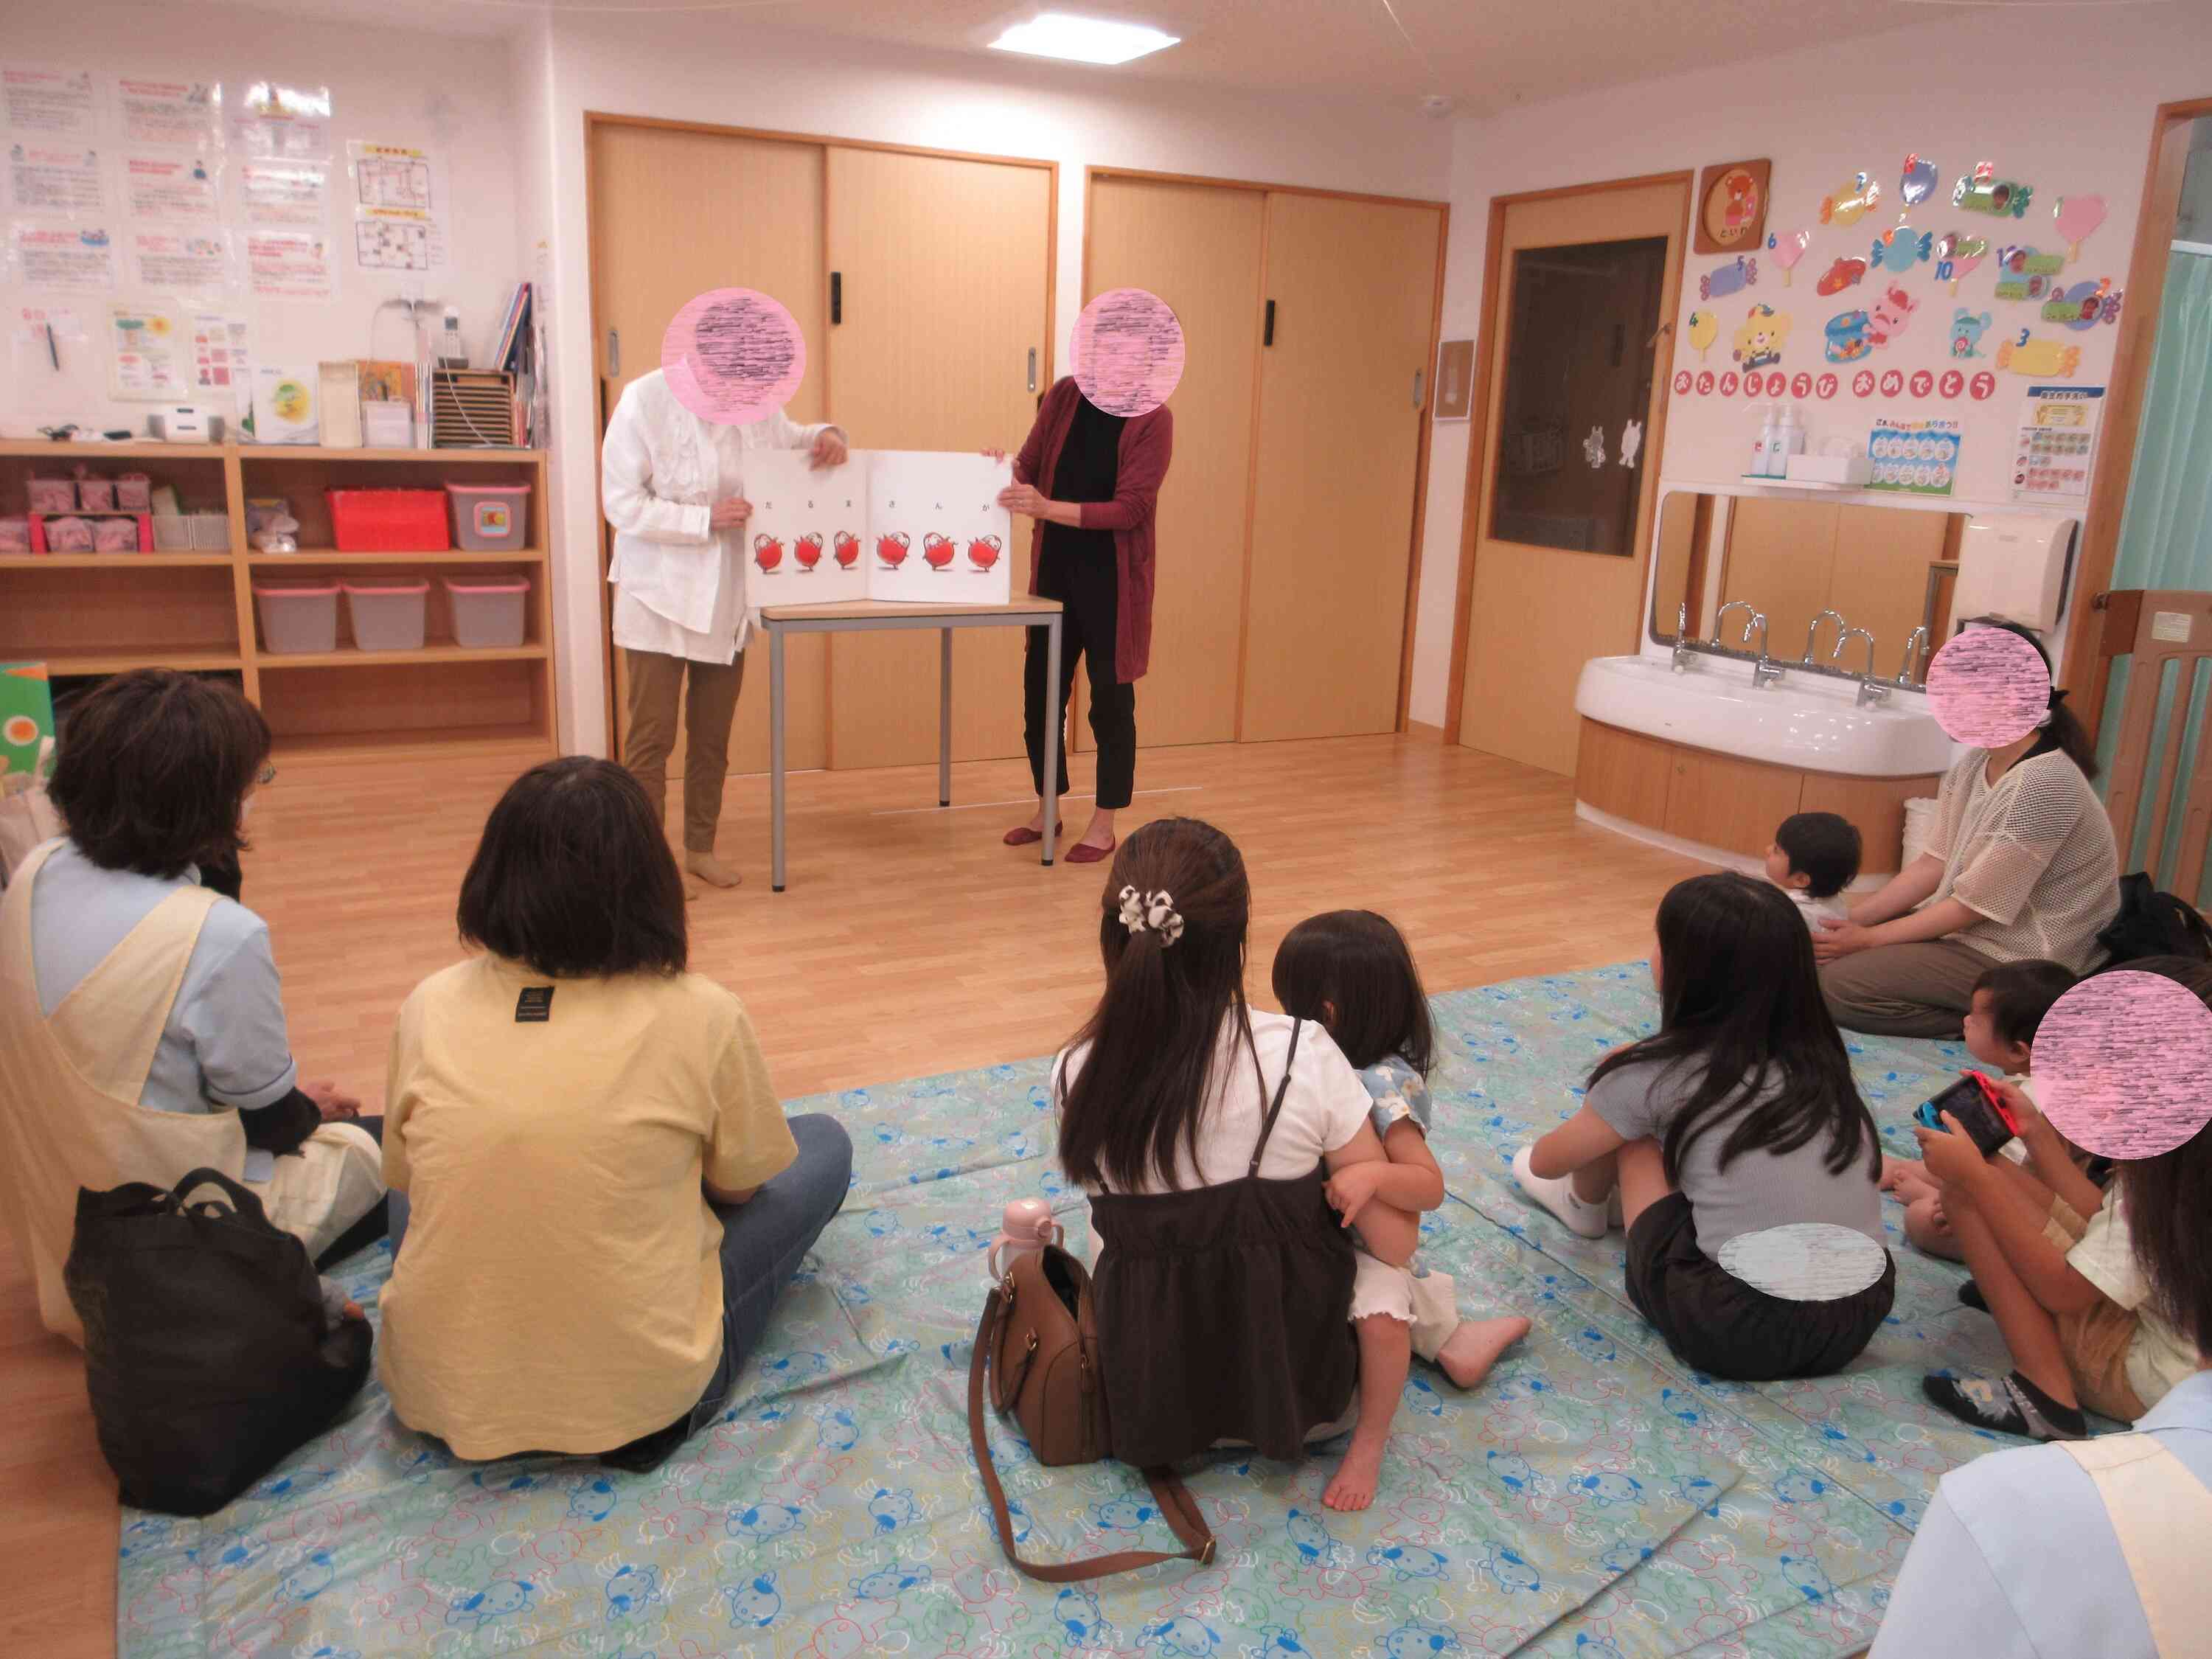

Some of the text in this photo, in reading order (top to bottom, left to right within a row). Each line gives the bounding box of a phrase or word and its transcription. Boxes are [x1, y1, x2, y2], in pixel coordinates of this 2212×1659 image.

[1768, 233, 1777, 249] 6
[1934, 260, 1954, 281] 10
[1689, 312, 1699, 327] 4
[2016, 328, 2031, 347] 3
[1674, 369, 1992, 398] おたんじょうび おめでとう
